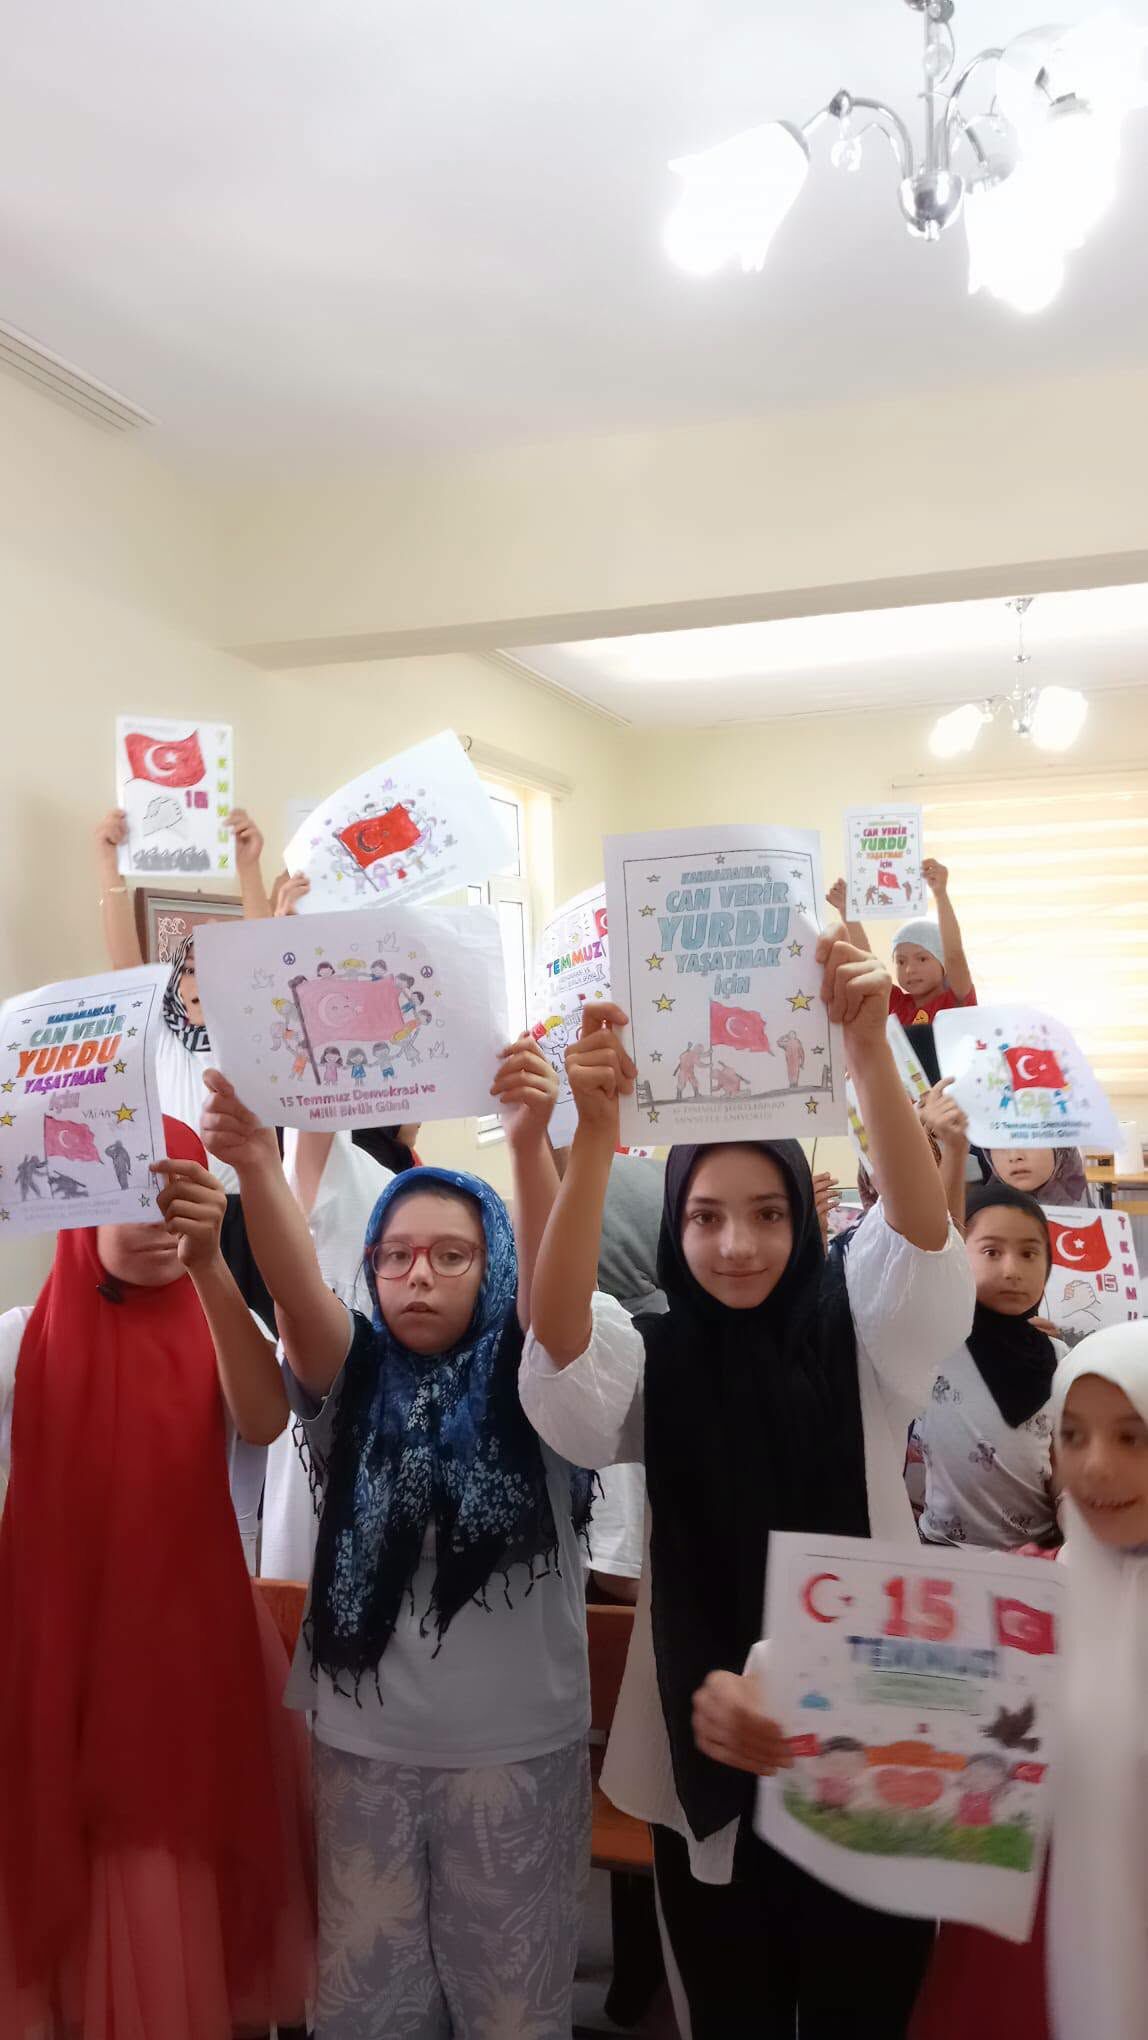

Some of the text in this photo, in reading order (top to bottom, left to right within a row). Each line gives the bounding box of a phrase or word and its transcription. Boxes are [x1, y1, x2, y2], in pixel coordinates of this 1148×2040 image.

[861, 836, 908, 851] YURDU
[666, 881, 789, 913] CAN VERİR
[657, 906, 790, 952] YURDU
[546, 941, 602, 978] TEMMUZ
[675, 947, 781, 976] YAŞATMAK
[30, 1026, 68, 1046] CAN
[16, 1033, 122, 1078] YURDU
[24, 1067, 108, 1095] YAŞATMAK
[279, 1083, 437, 1108] 15 Temmuz Demokrasi ve
[1096, 1273, 1118, 1292] 15
[882, 1575, 957, 1641] 15
